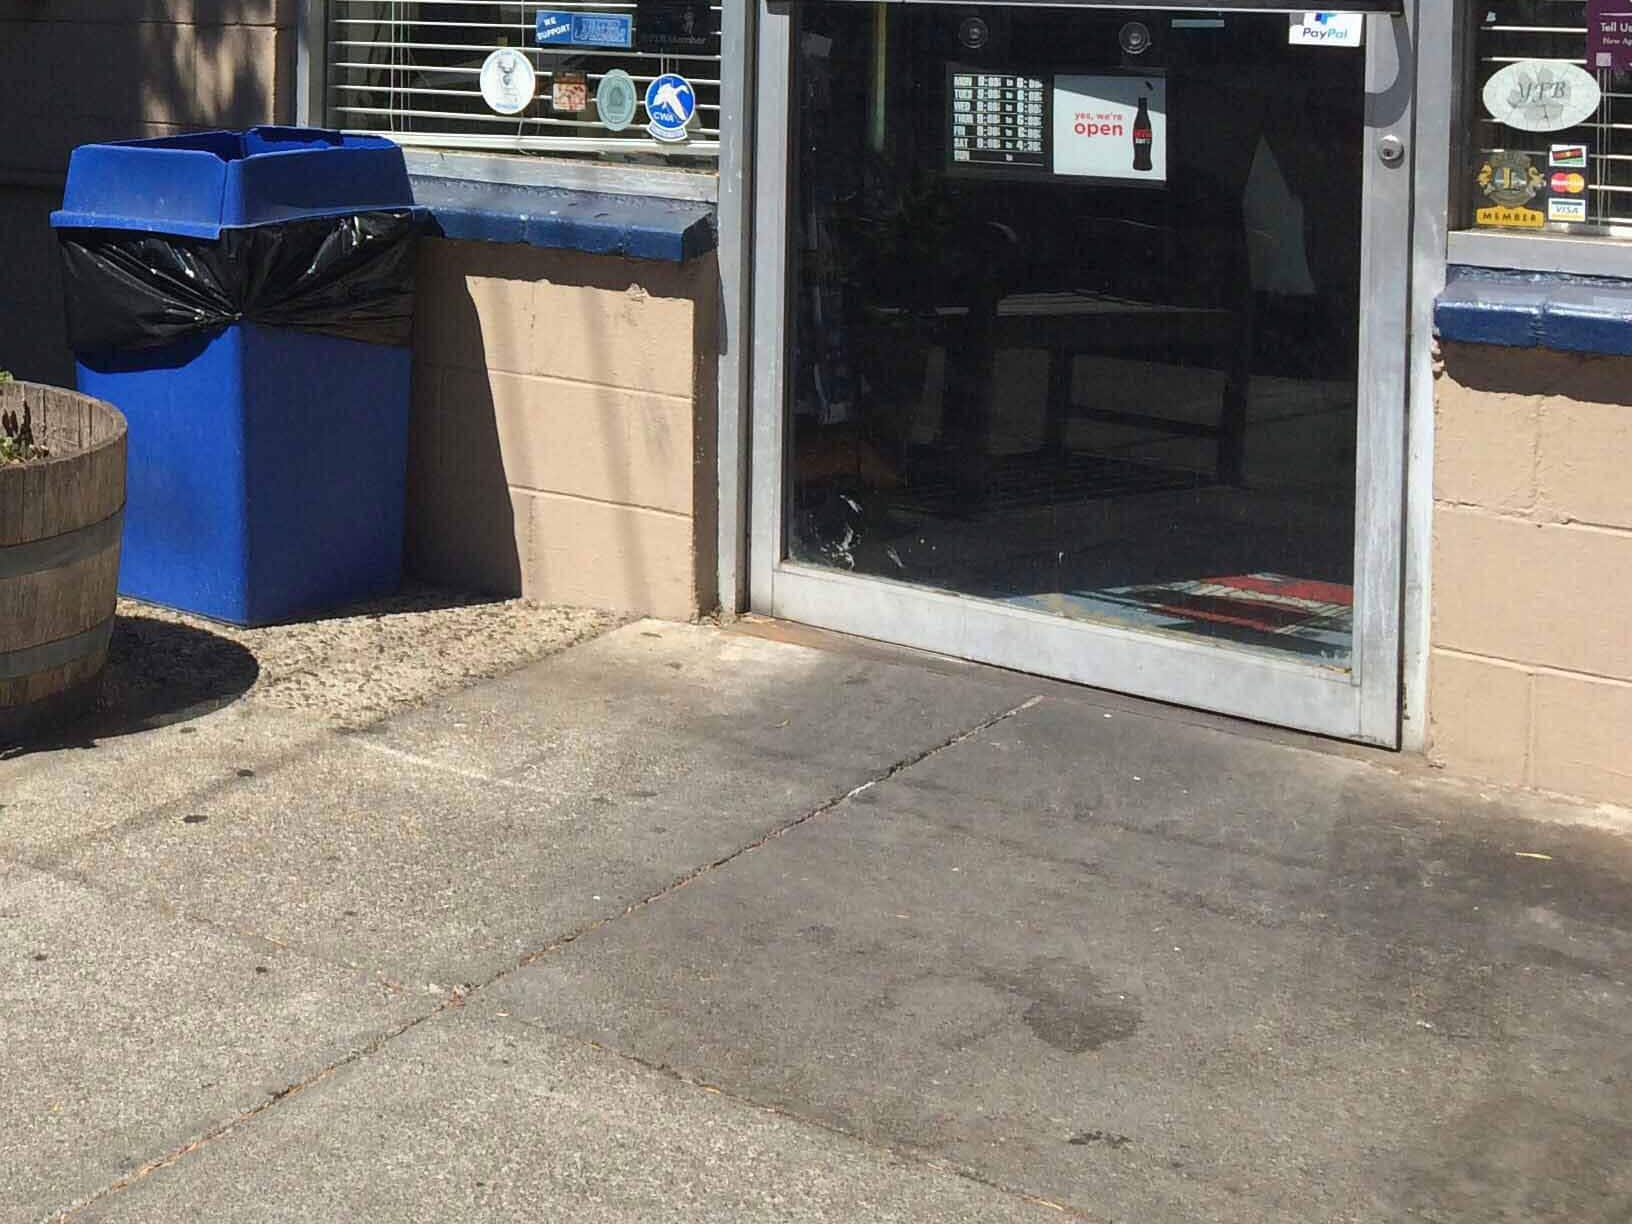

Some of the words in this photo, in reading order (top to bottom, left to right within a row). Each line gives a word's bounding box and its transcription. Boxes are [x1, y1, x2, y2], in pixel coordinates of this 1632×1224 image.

[537, 23, 571, 42] SUPPORT
[1301, 26, 1349, 41] PayPal
[1074, 122, 1124, 137] open
[1482, 210, 1538, 223] MEMBER
[1555, 206, 1579, 215] VISA
